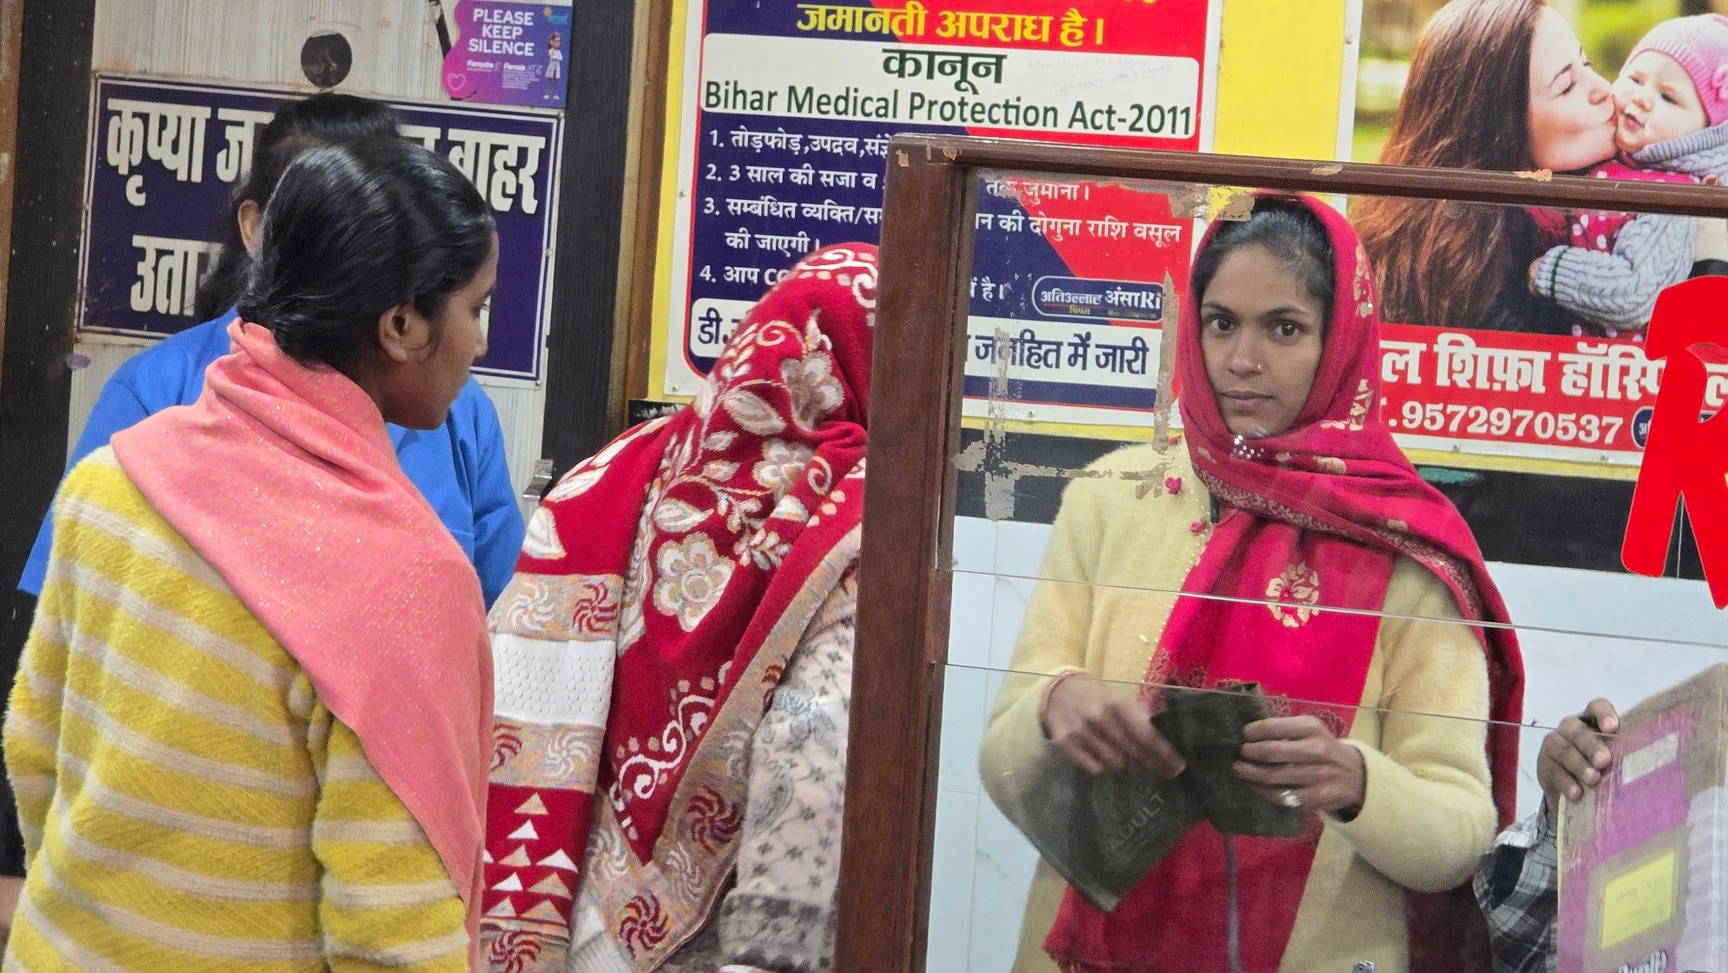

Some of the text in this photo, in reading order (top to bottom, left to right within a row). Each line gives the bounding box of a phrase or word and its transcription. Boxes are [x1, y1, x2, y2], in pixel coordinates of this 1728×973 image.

[473, 8, 535, 26] PLEASE
[797, 1, 927, 36] जमानती
[936, 9, 1054, 43] अपराध
[482, 24, 523, 39] KEEP
[468, 38, 535, 56] SILENCE
[882, 48, 1007, 95] कानून
[705, 80, 1191, 136] Bihar Medical Protection Act-2011
[709, 129, 725, 148] 1.
[107, 98, 211, 206] कृप्या
[705, 163, 878, 190] 2. 3 साल की सजा व
[703, 196, 720, 216] 3.
[724, 227, 751, 250] की
[997, 210, 1025, 232] की
[1029, 211, 1083, 242] दोगुना
[1087, 215, 1129, 239] राशि
[1133, 222, 1182, 247] वसूल
[700, 265, 716, 283] 4.
[724, 266, 760, 284] आप
[1067, 332, 1092, 371] में
[1095, 336, 1150, 375] जारी
